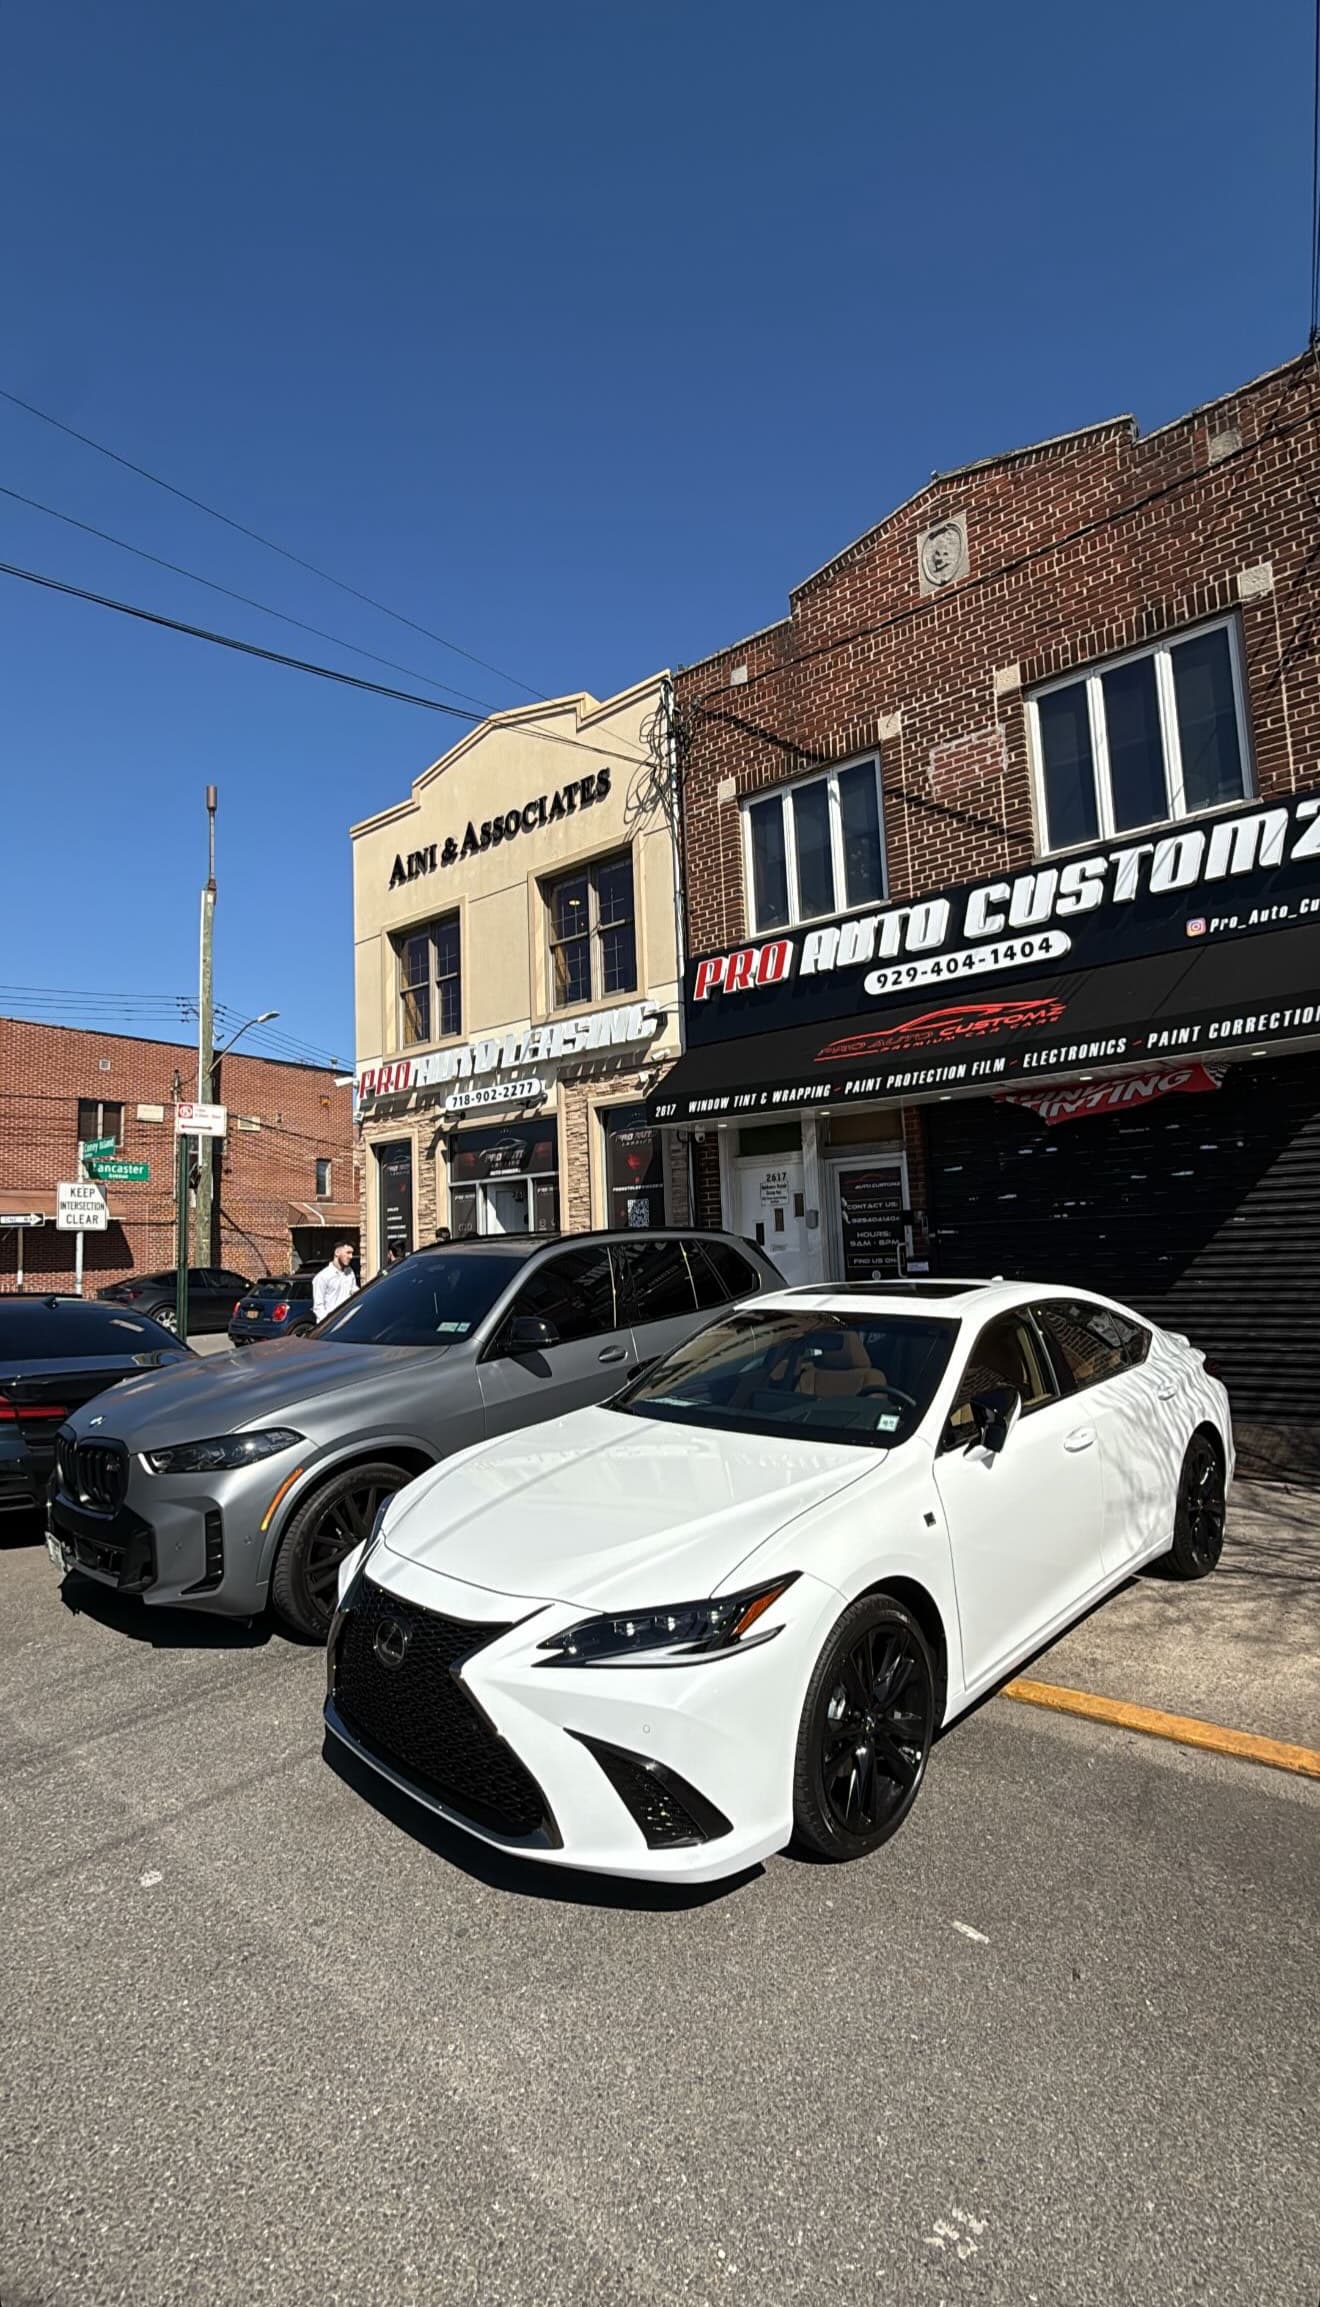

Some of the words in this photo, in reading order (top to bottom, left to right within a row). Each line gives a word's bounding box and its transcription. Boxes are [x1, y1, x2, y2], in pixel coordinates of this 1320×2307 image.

[389, 853, 438, 890] AINI
[441, 837, 458, 868] &
[460, 768, 611, 860] ASSOCIATES
[692, 940, 794, 1001] PRO
[799, 898, 950, 976] AUTO
[876, 936, 1053, 990] 929-404-1404
[938, 1003, 1066, 1037] CUSTOMZ
[358, 1060, 413, 1100] PRO
[413, 1040, 499, 1087] AUTO
[655, 1104, 677, 1118] 2617
[688, 1097, 730, 1113] WINDOW
[733, 1093, 758, 1107] TINT
[772, 1084, 832, 1104] WRAPPING
[844, 1076, 883, 1095] PAINT
[886, 1063, 968, 1089] PROTECTION
[971, 1057, 1006, 1077] FILM
[1022, 1038, 1127, 1068] ELECTRONICS
[1146, 1025, 1202, 1049] PAINT
[452, 1081, 534, 1107] 718-902-2277
[766, 1172, 787, 1182] 2617
[61, 1201, 105, 1211] INTERSECTION
[70, 1187, 95, 1198] KEEP
[847, 1202, 883, 1211] CONTACT
[66, 1214, 99, 1225] CLEAR
